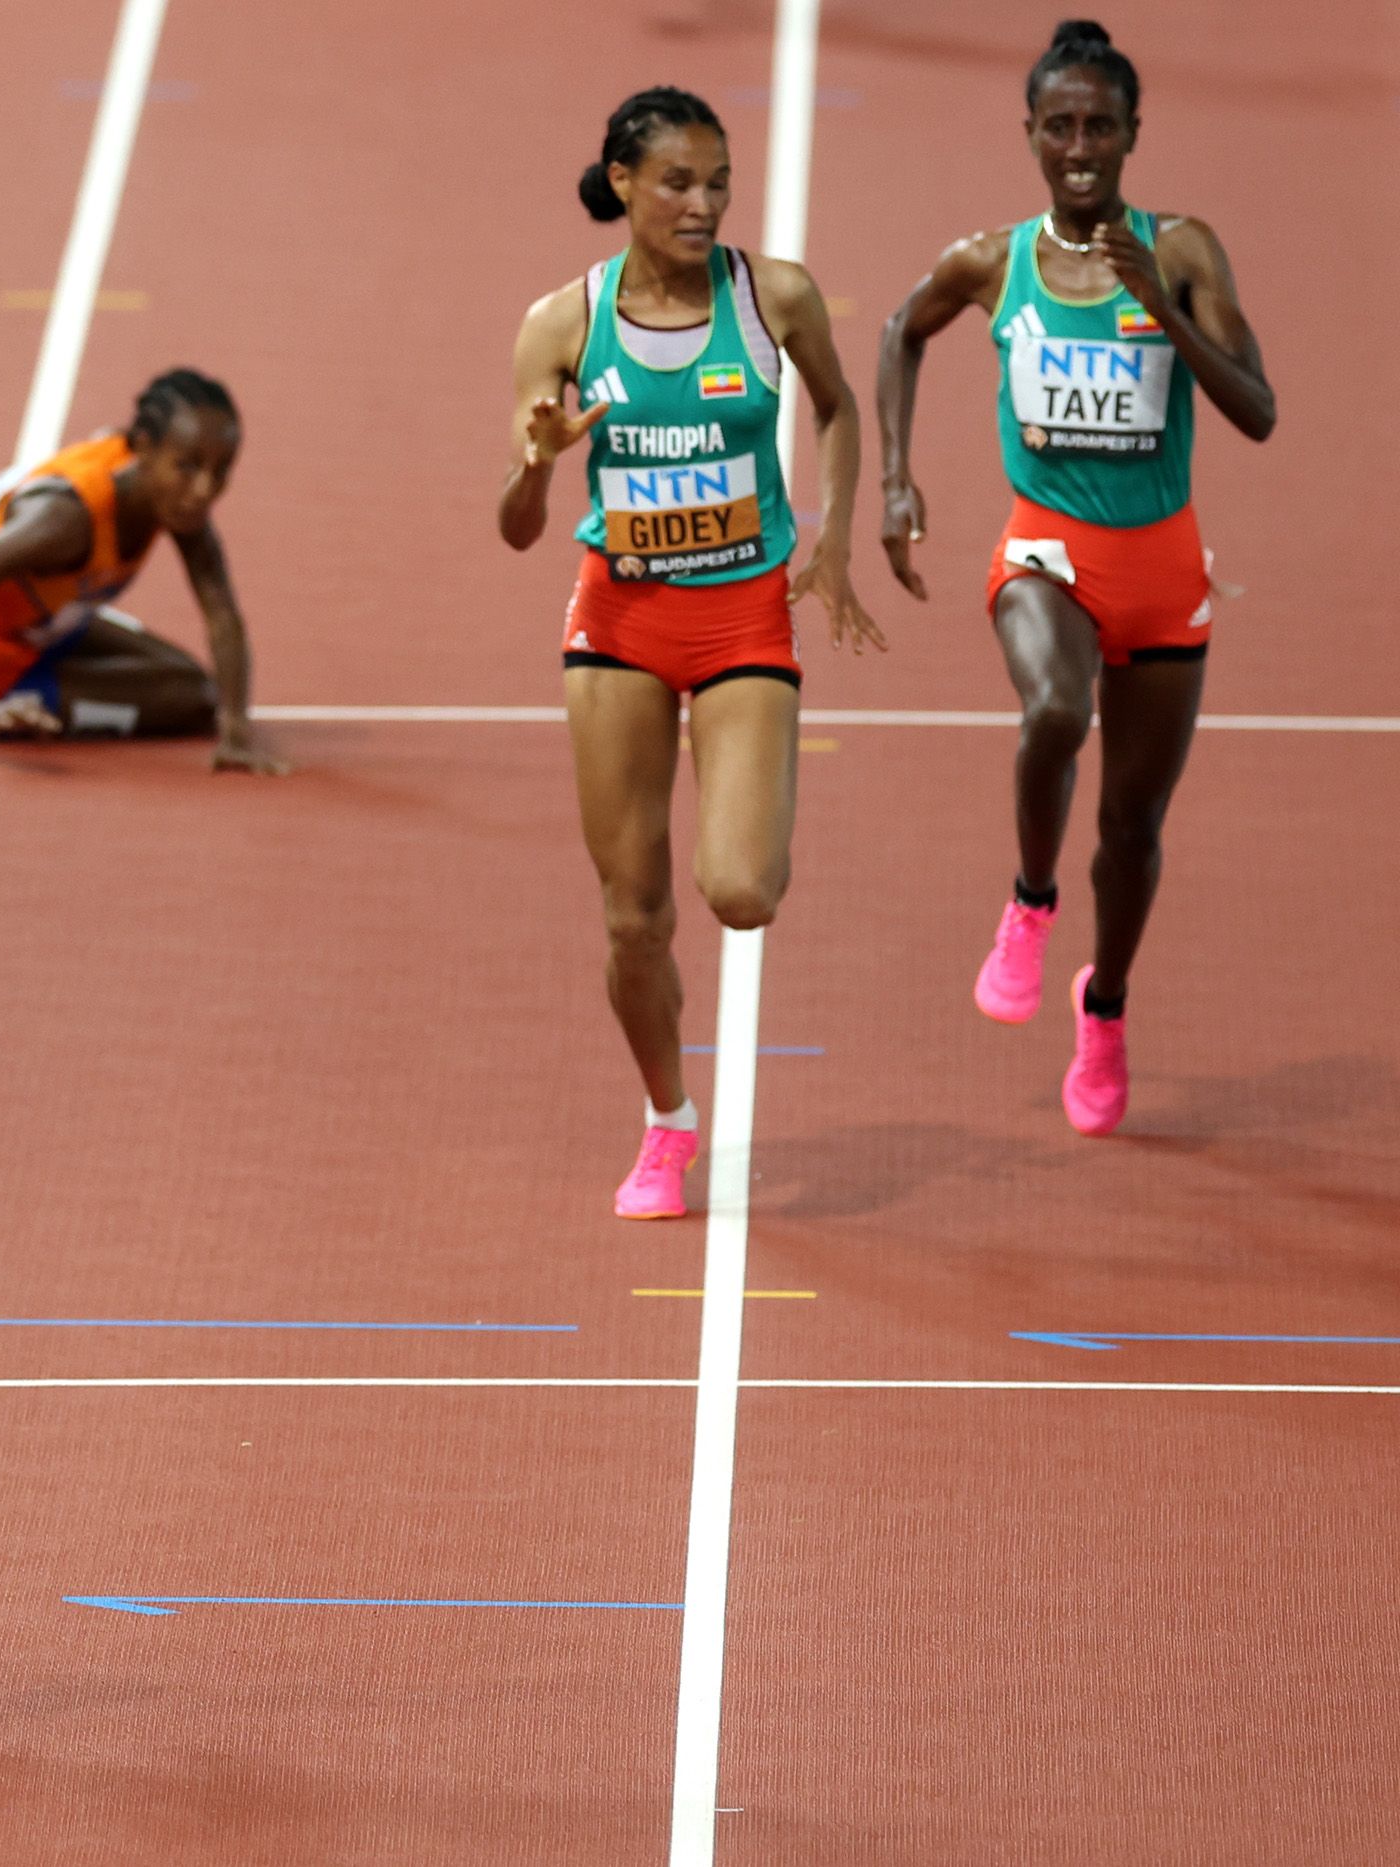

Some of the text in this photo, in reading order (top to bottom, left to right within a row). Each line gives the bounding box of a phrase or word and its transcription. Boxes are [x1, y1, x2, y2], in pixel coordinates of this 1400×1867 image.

[1039, 344, 1143, 383] NTN
[1043, 386, 1134, 424] TAYE
[607, 422, 726, 459] ETHIOPIA
[626, 464, 730, 506] NTN
[629, 507, 733, 549] GIDEY
